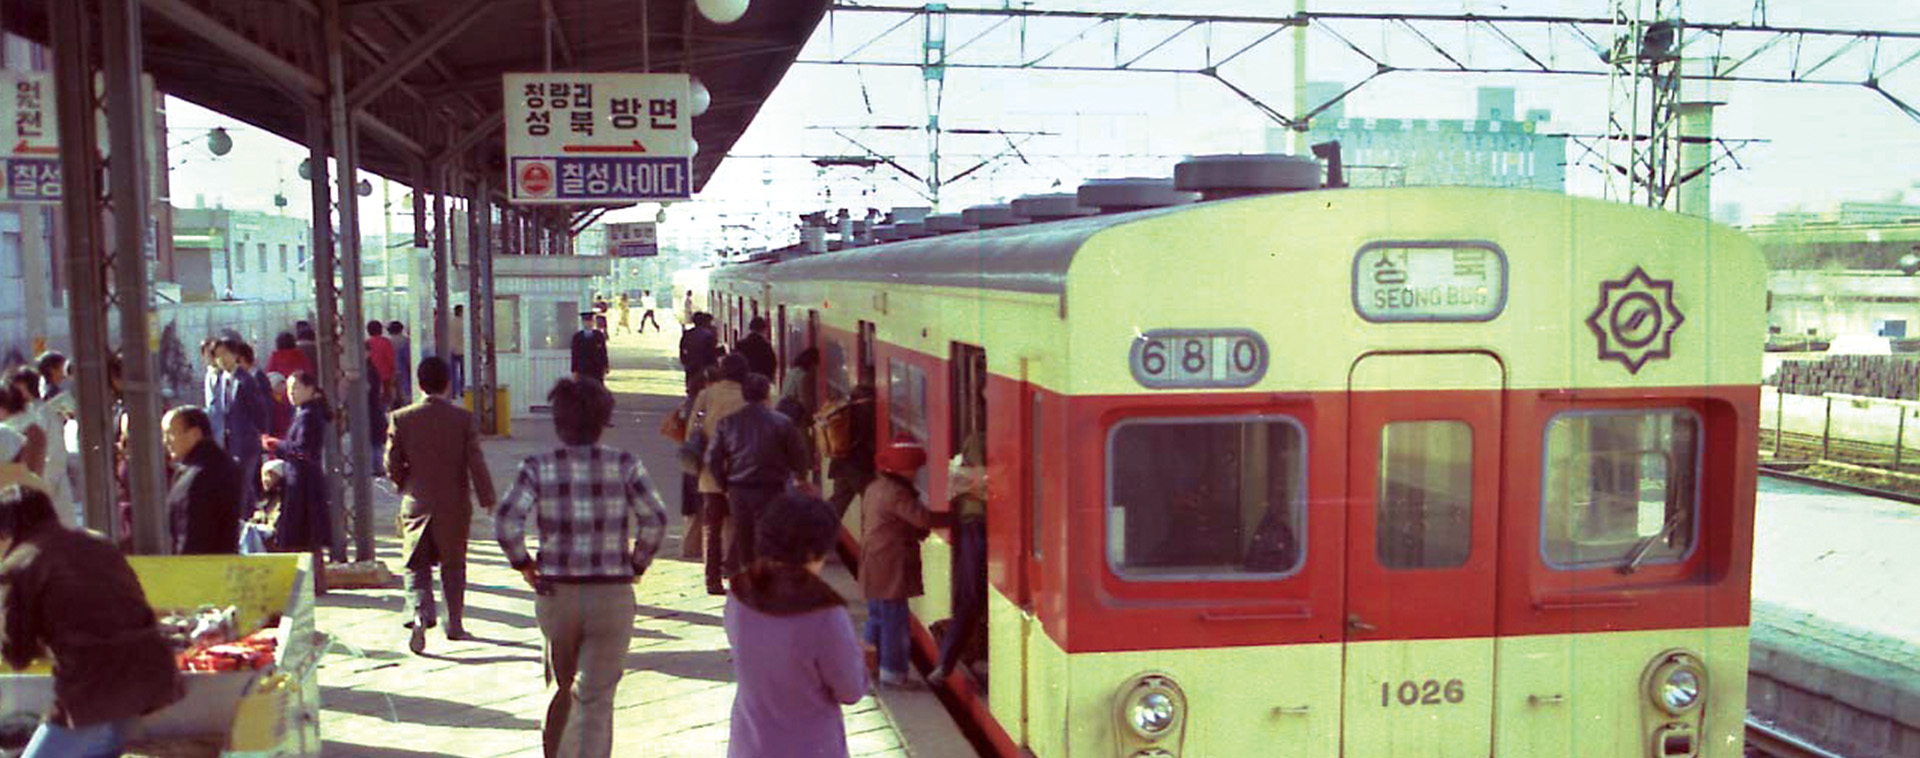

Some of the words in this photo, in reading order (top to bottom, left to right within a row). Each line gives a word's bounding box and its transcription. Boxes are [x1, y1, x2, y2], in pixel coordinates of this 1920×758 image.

[610, 97, 677, 130] 방면
[561, 162, 684, 195] 칠성사이다
[1141, 339, 1259, 375] 680
[1381, 679, 1464, 707] 1026
